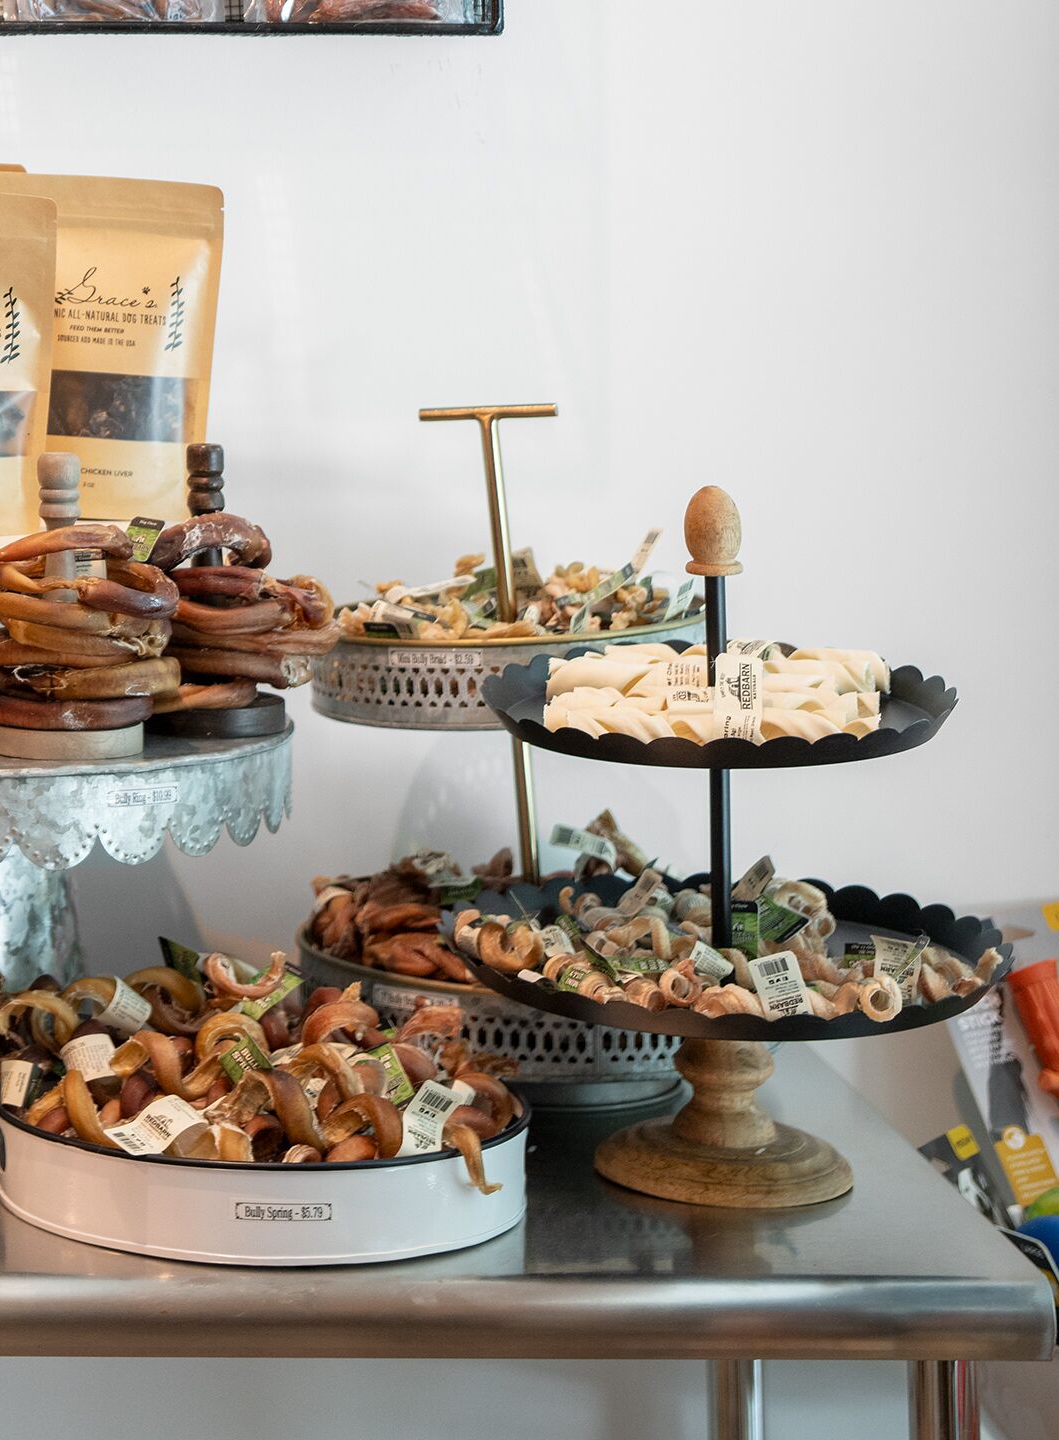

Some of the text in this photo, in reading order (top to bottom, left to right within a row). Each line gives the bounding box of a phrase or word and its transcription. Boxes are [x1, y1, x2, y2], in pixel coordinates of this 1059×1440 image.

[59, 267, 157, 308] Grace's
[68, 311, 118, 323] ALL-NATURAL
[122, 313, 137, 324] DOG
[141, 313, 166, 326] TREATS
[93, 336, 105, 344] MADE
[81, 468, 133, 477] CHICKEN LIVER
[742, 663, 751, 710] REDBARN
[144, 1113, 171, 1139] REDBARN
[245, 1206, 323, 1220] Bully Spring $5.79
